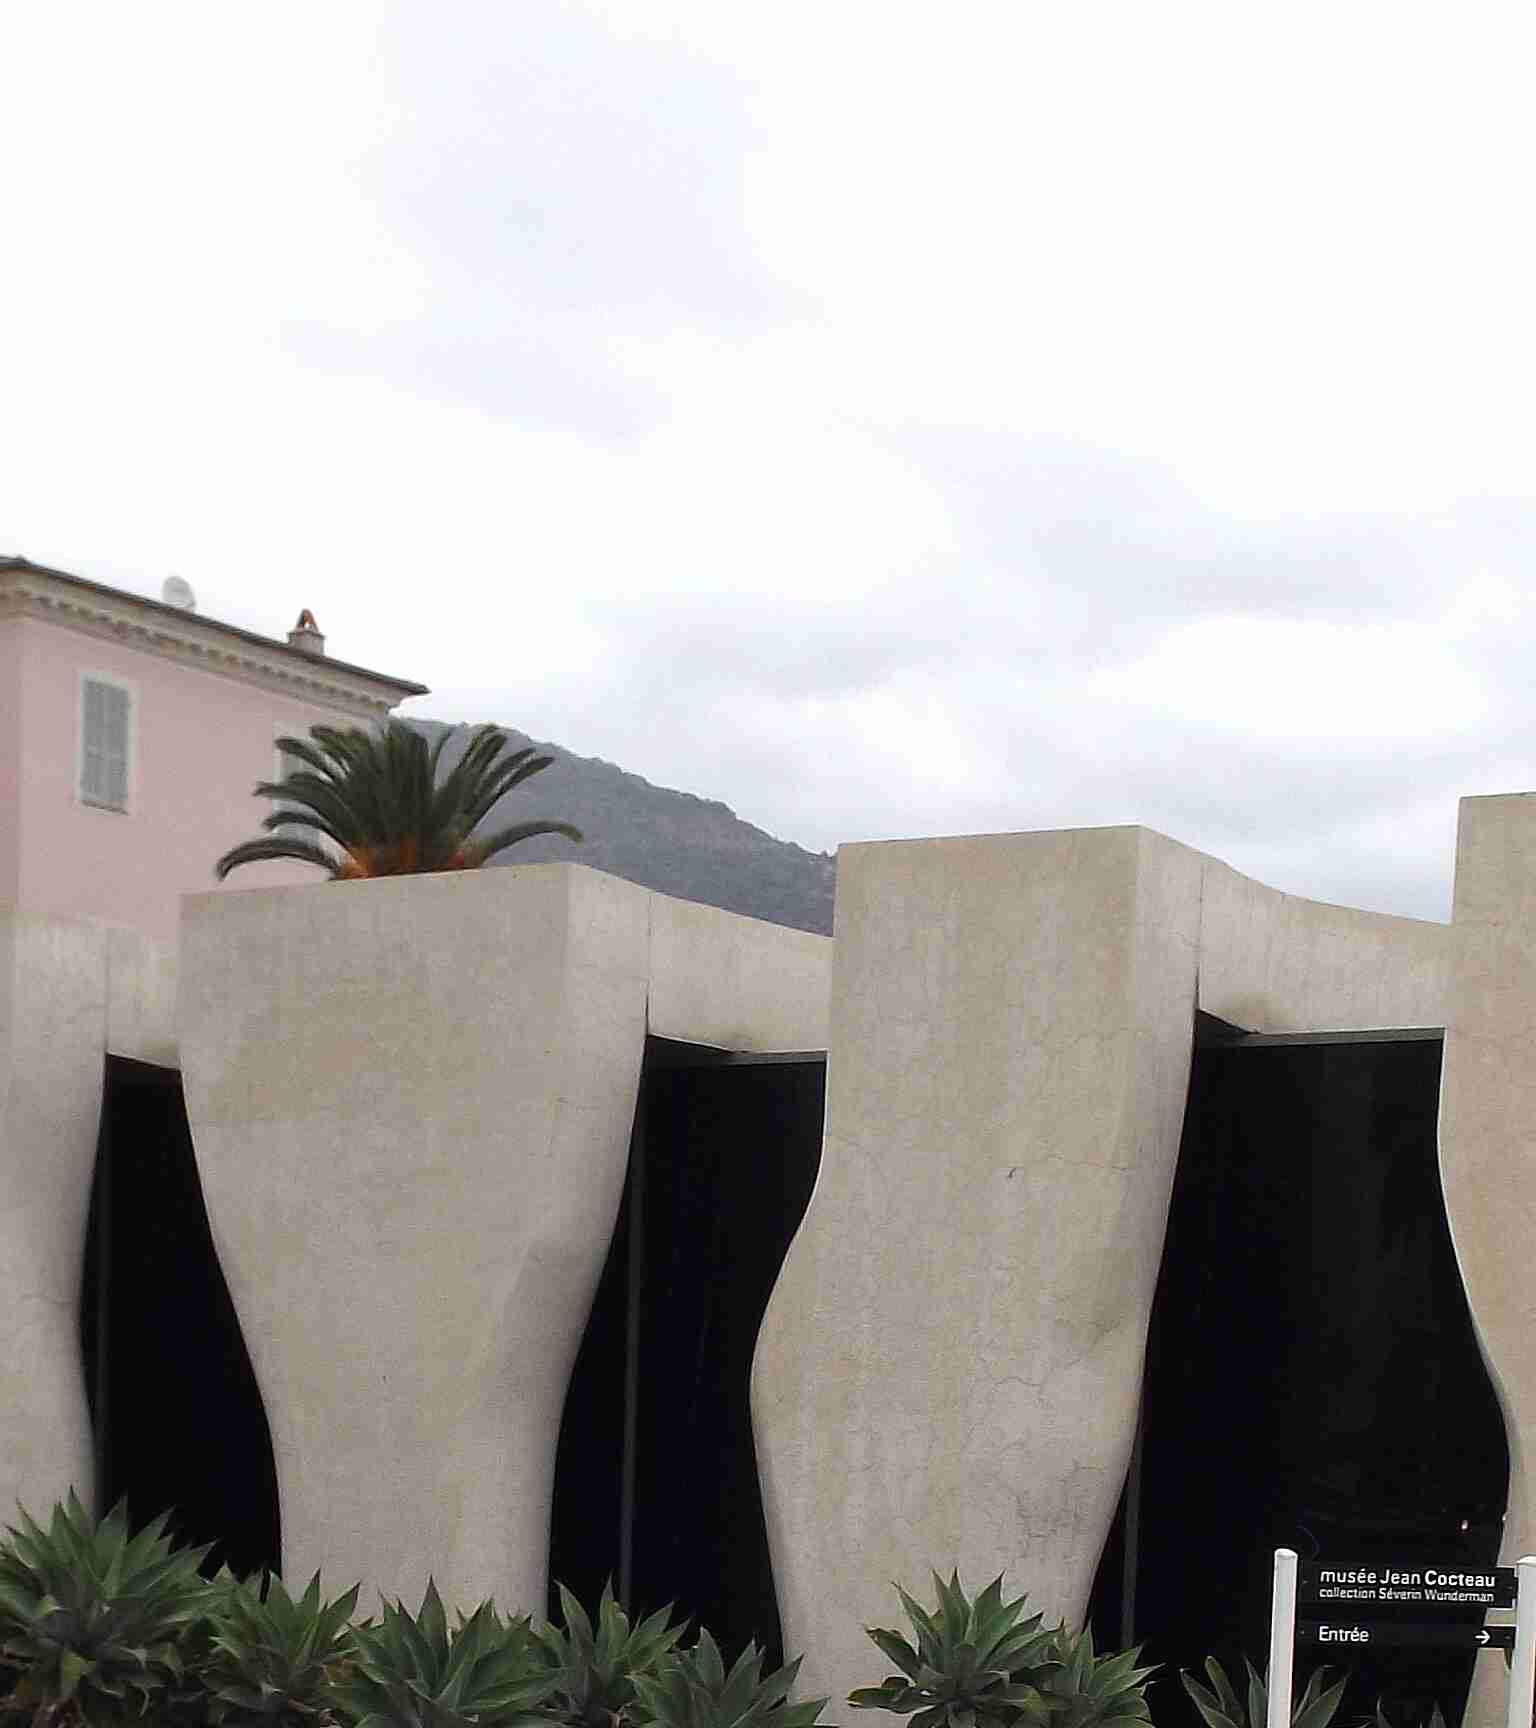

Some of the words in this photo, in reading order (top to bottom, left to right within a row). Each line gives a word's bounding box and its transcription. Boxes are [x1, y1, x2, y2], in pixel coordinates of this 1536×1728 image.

[1320, 1568, 1377, 1584] musée
[1380, 1569, 1421, 1585] Jean
[1424, 1570, 1496, 1587] Cocteau
[1319, 1587, 1376, 1599] collection
[1378, 1587, 1422, 1600] Séverin
[1424, 1588, 1495, 1602] Wunderman
[1318, 1625, 1369, 1643] Entrée
